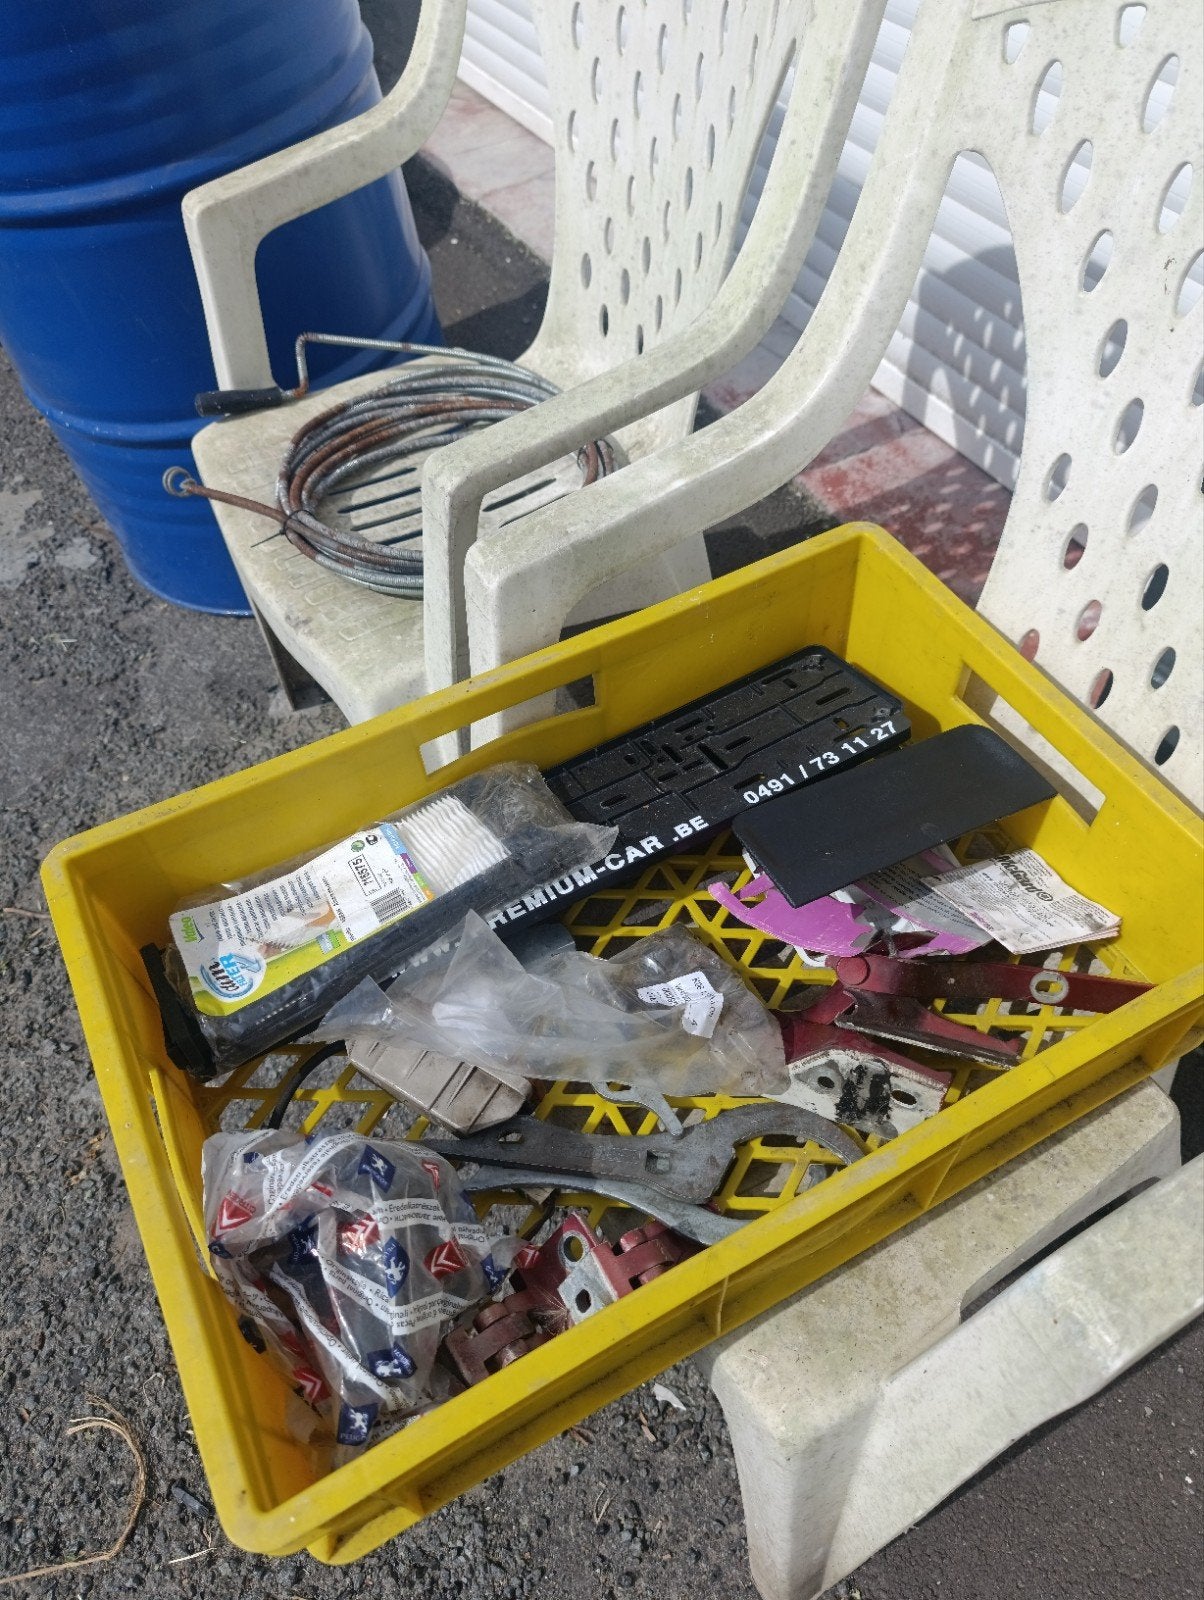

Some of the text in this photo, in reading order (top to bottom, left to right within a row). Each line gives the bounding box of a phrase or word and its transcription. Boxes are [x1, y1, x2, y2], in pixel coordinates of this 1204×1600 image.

[743, 720, 897, 803] 0491 / 73 11 27
